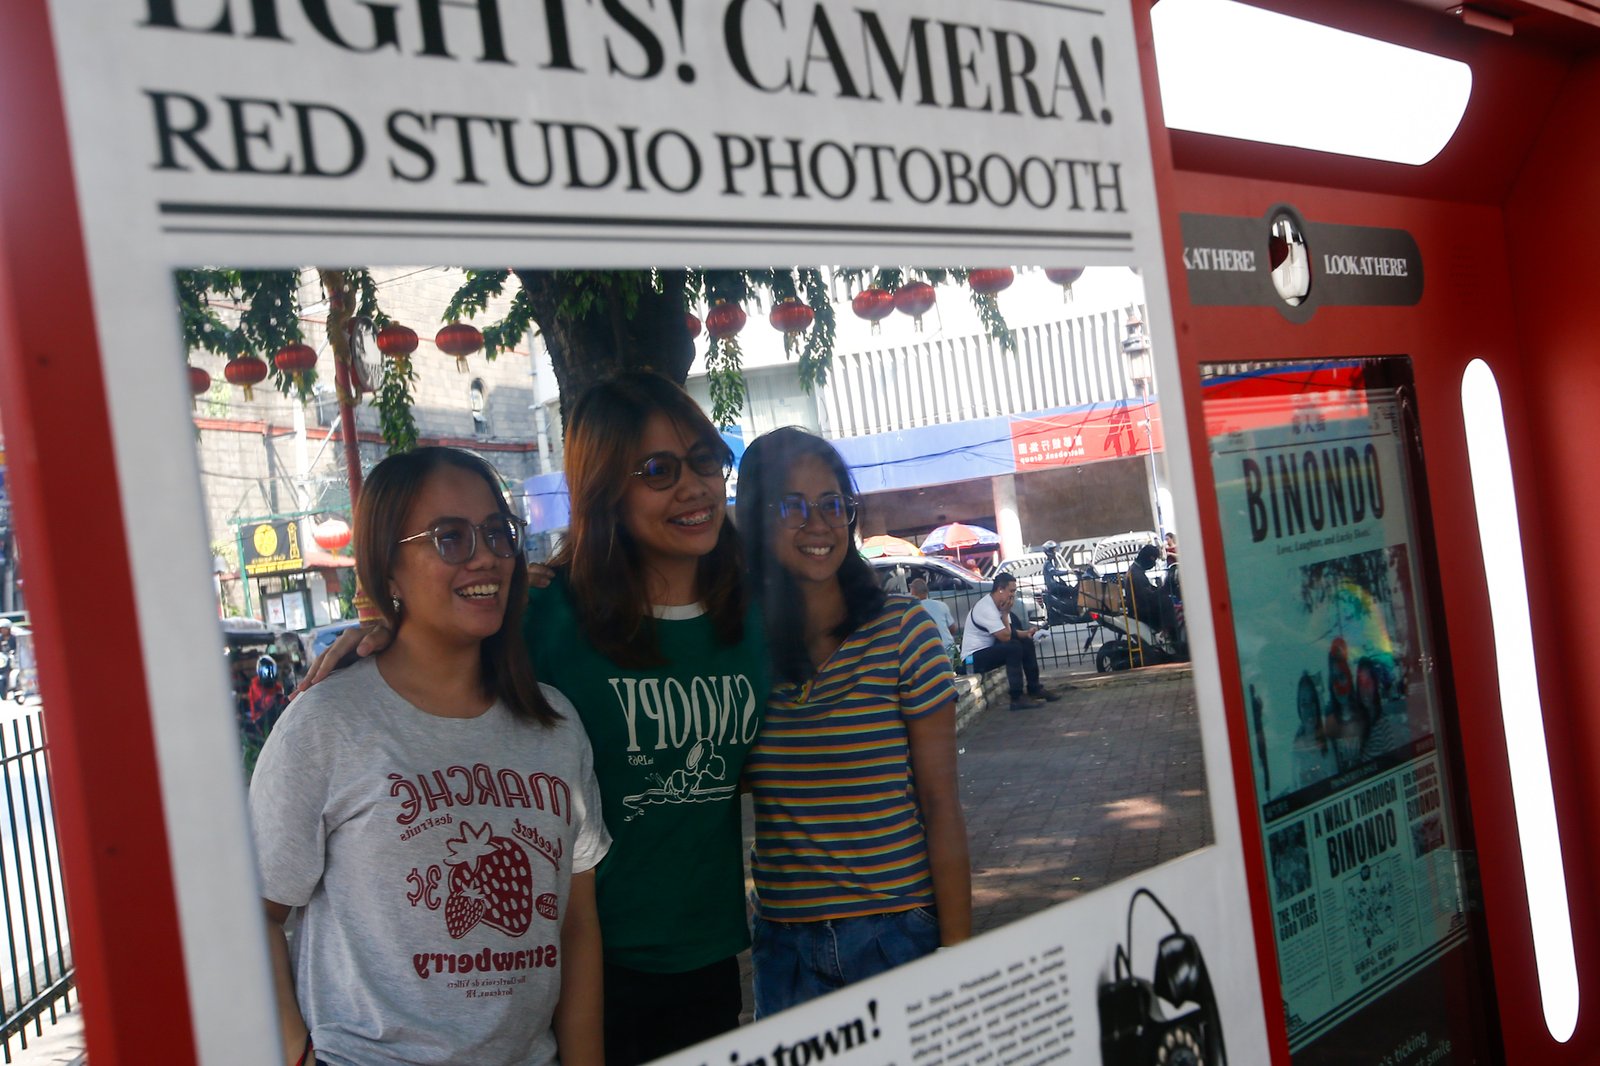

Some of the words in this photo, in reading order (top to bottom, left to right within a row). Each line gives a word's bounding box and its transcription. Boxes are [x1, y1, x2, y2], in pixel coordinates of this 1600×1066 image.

[136, 0, 696, 84] HTS!
[722, 0, 1115, 125] CAMERA!
[142, 89, 366, 178] RED
[385, 109, 702, 193] STUDIO
[713, 133, 1127, 213] PHOTOBOOTH
[1242, 442, 1385, 543] BINONDO
[1322, 797, 1353, 833] WALK
[1353, 777, 1398, 819] THROUGH
[1326, 807, 1398, 879] BINONDO
[772, 999, 881, 1066] town!
[1394, 1031, 1428, 1062] ticking
